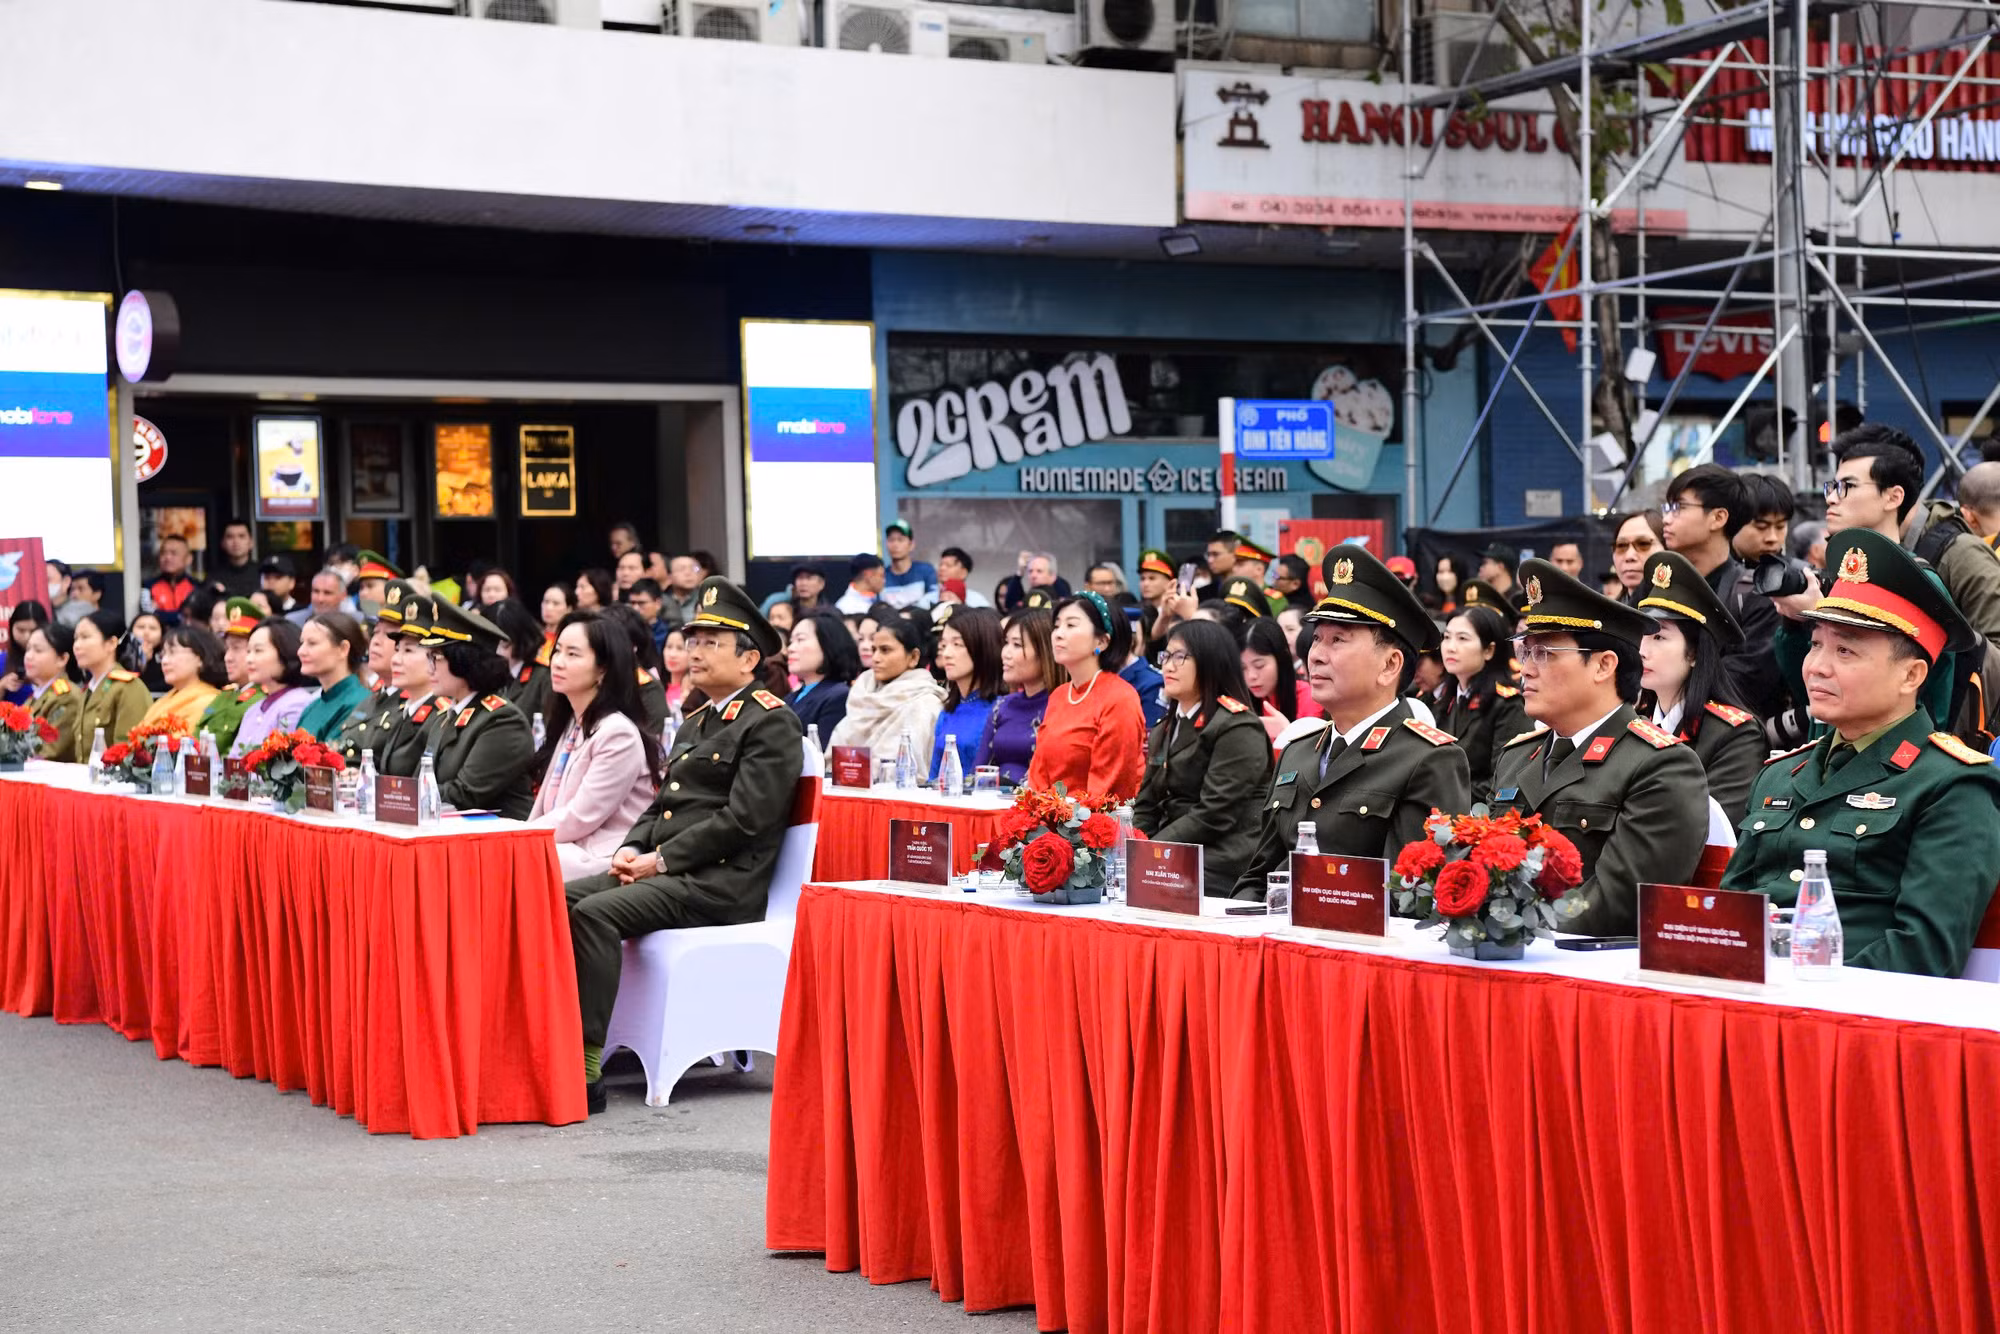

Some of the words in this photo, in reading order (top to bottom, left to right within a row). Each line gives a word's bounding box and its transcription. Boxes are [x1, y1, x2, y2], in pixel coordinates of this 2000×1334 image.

[1300, 99, 1435, 149] HANOI
[1445, 106, 1548, 153] SOUL
[1020, 466, 1147, 493] HOMEMADE
[1181, 467, 1212, 493] ICE
